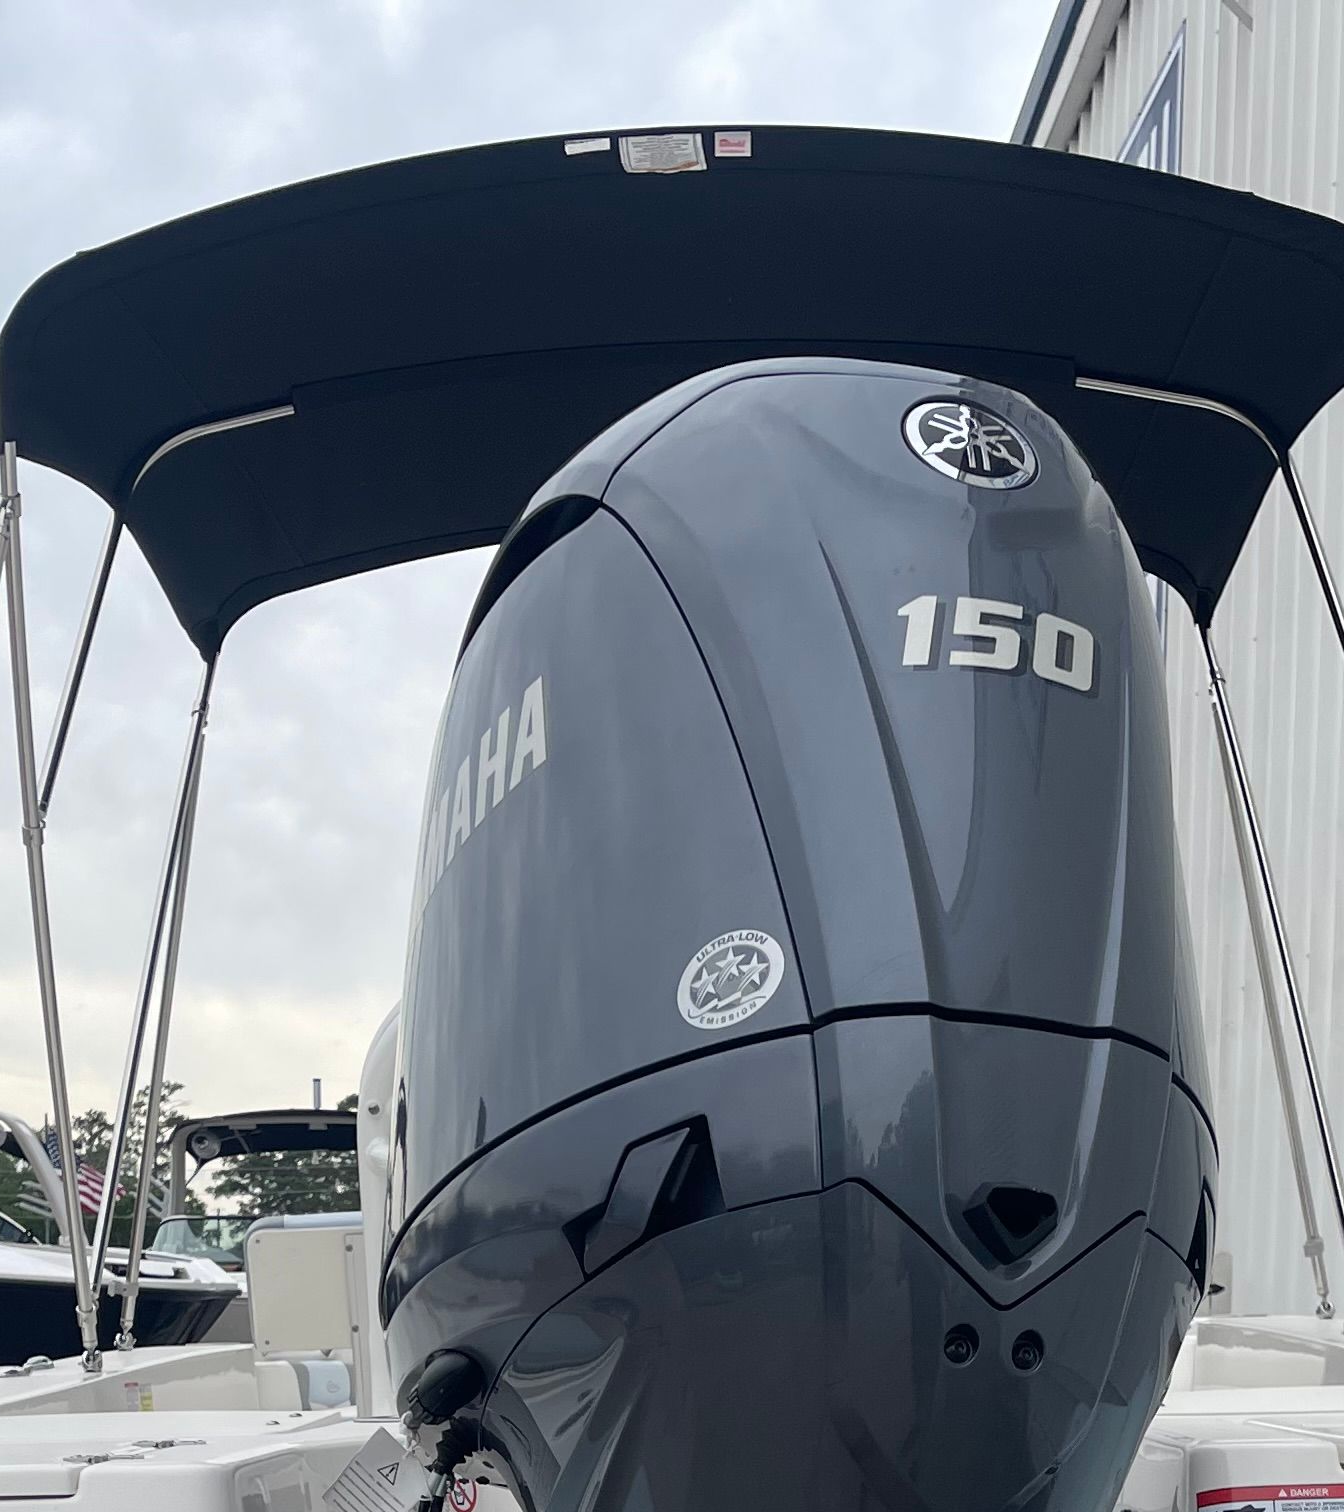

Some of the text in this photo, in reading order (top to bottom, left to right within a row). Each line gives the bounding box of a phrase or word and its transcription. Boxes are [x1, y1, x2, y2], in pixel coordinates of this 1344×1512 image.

[897, 595, 1094, 692] 150
[421, 675, 547, 914] MAHA
[699, 1001, 757, 1025] EMISSION
[1289, 1487, 1330, 1498] DANGER
